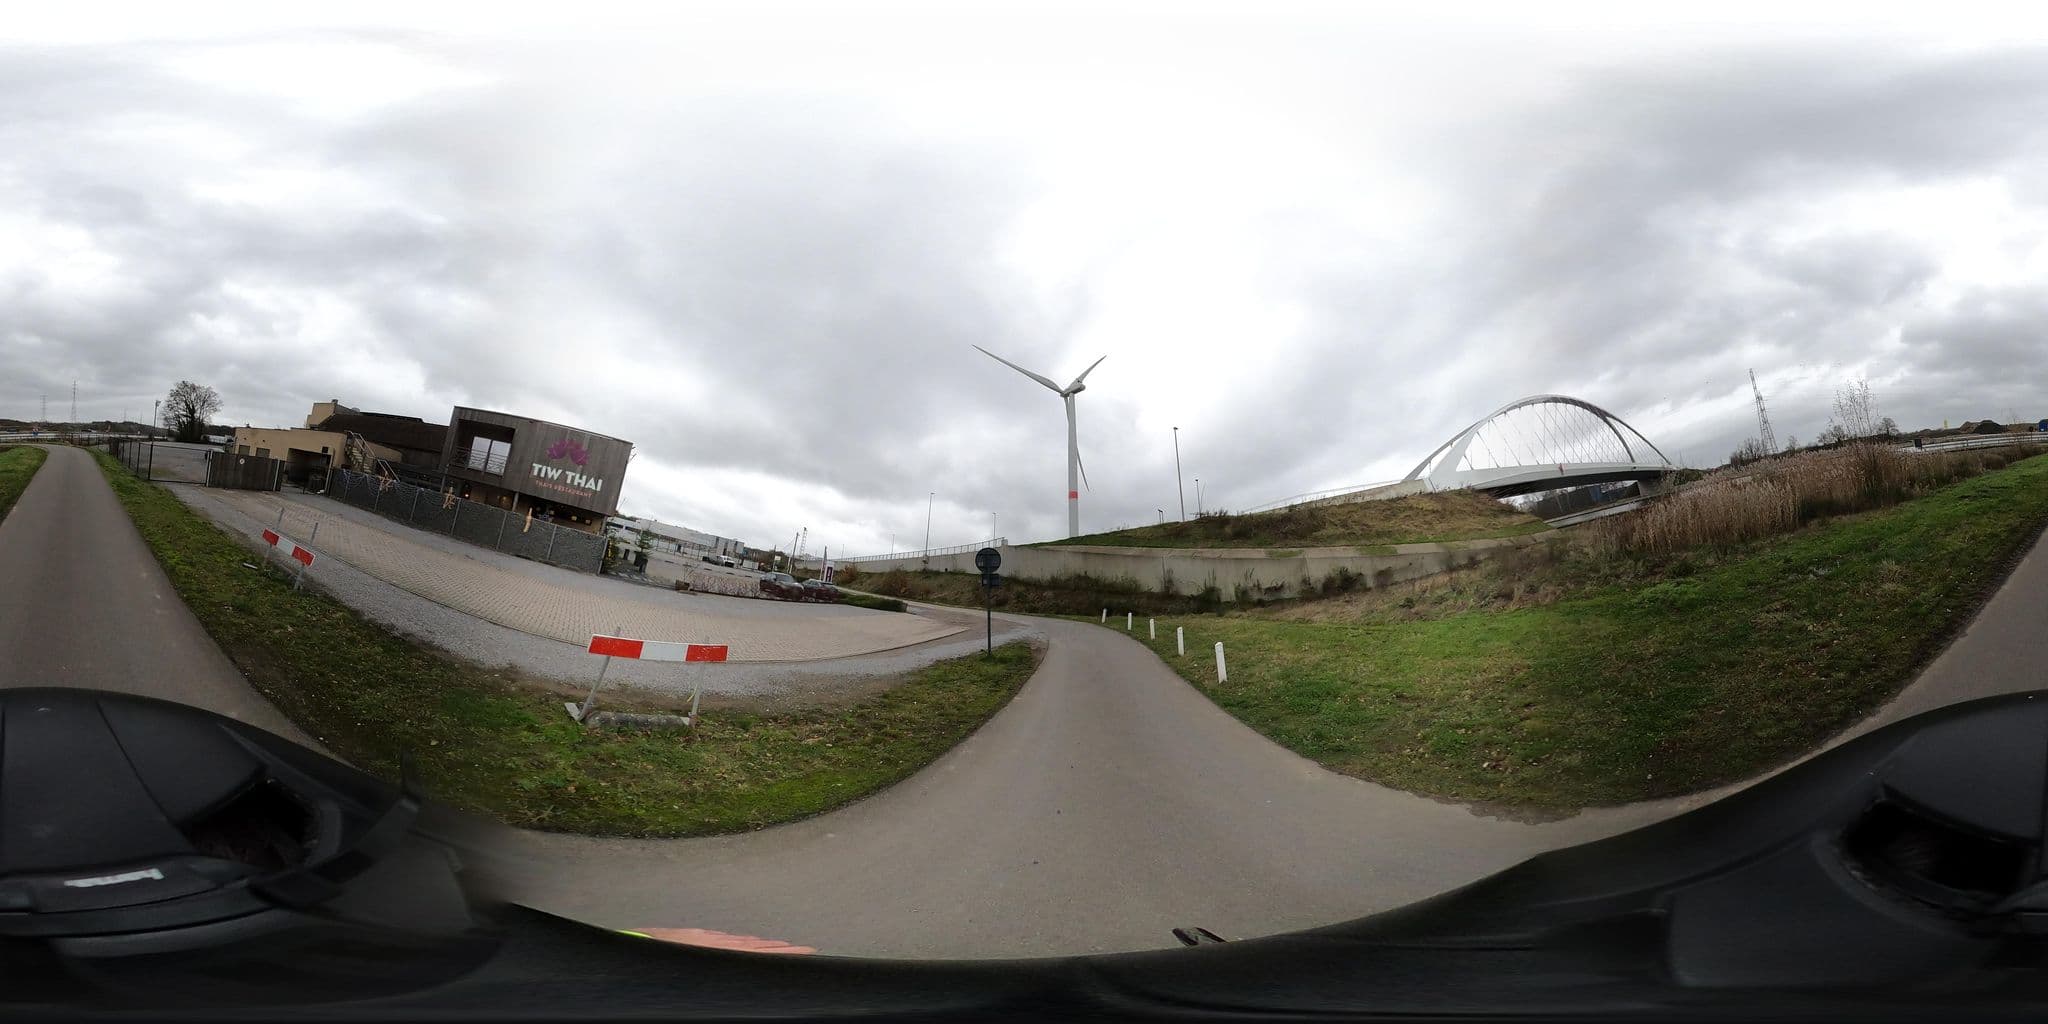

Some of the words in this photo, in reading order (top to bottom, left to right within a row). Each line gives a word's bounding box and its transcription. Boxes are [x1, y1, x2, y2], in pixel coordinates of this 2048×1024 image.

[532, 463, 562, 480] TIW
[565, 471, 603, 492] THAI
[554, 484, 593, 498] RESTAURANT
